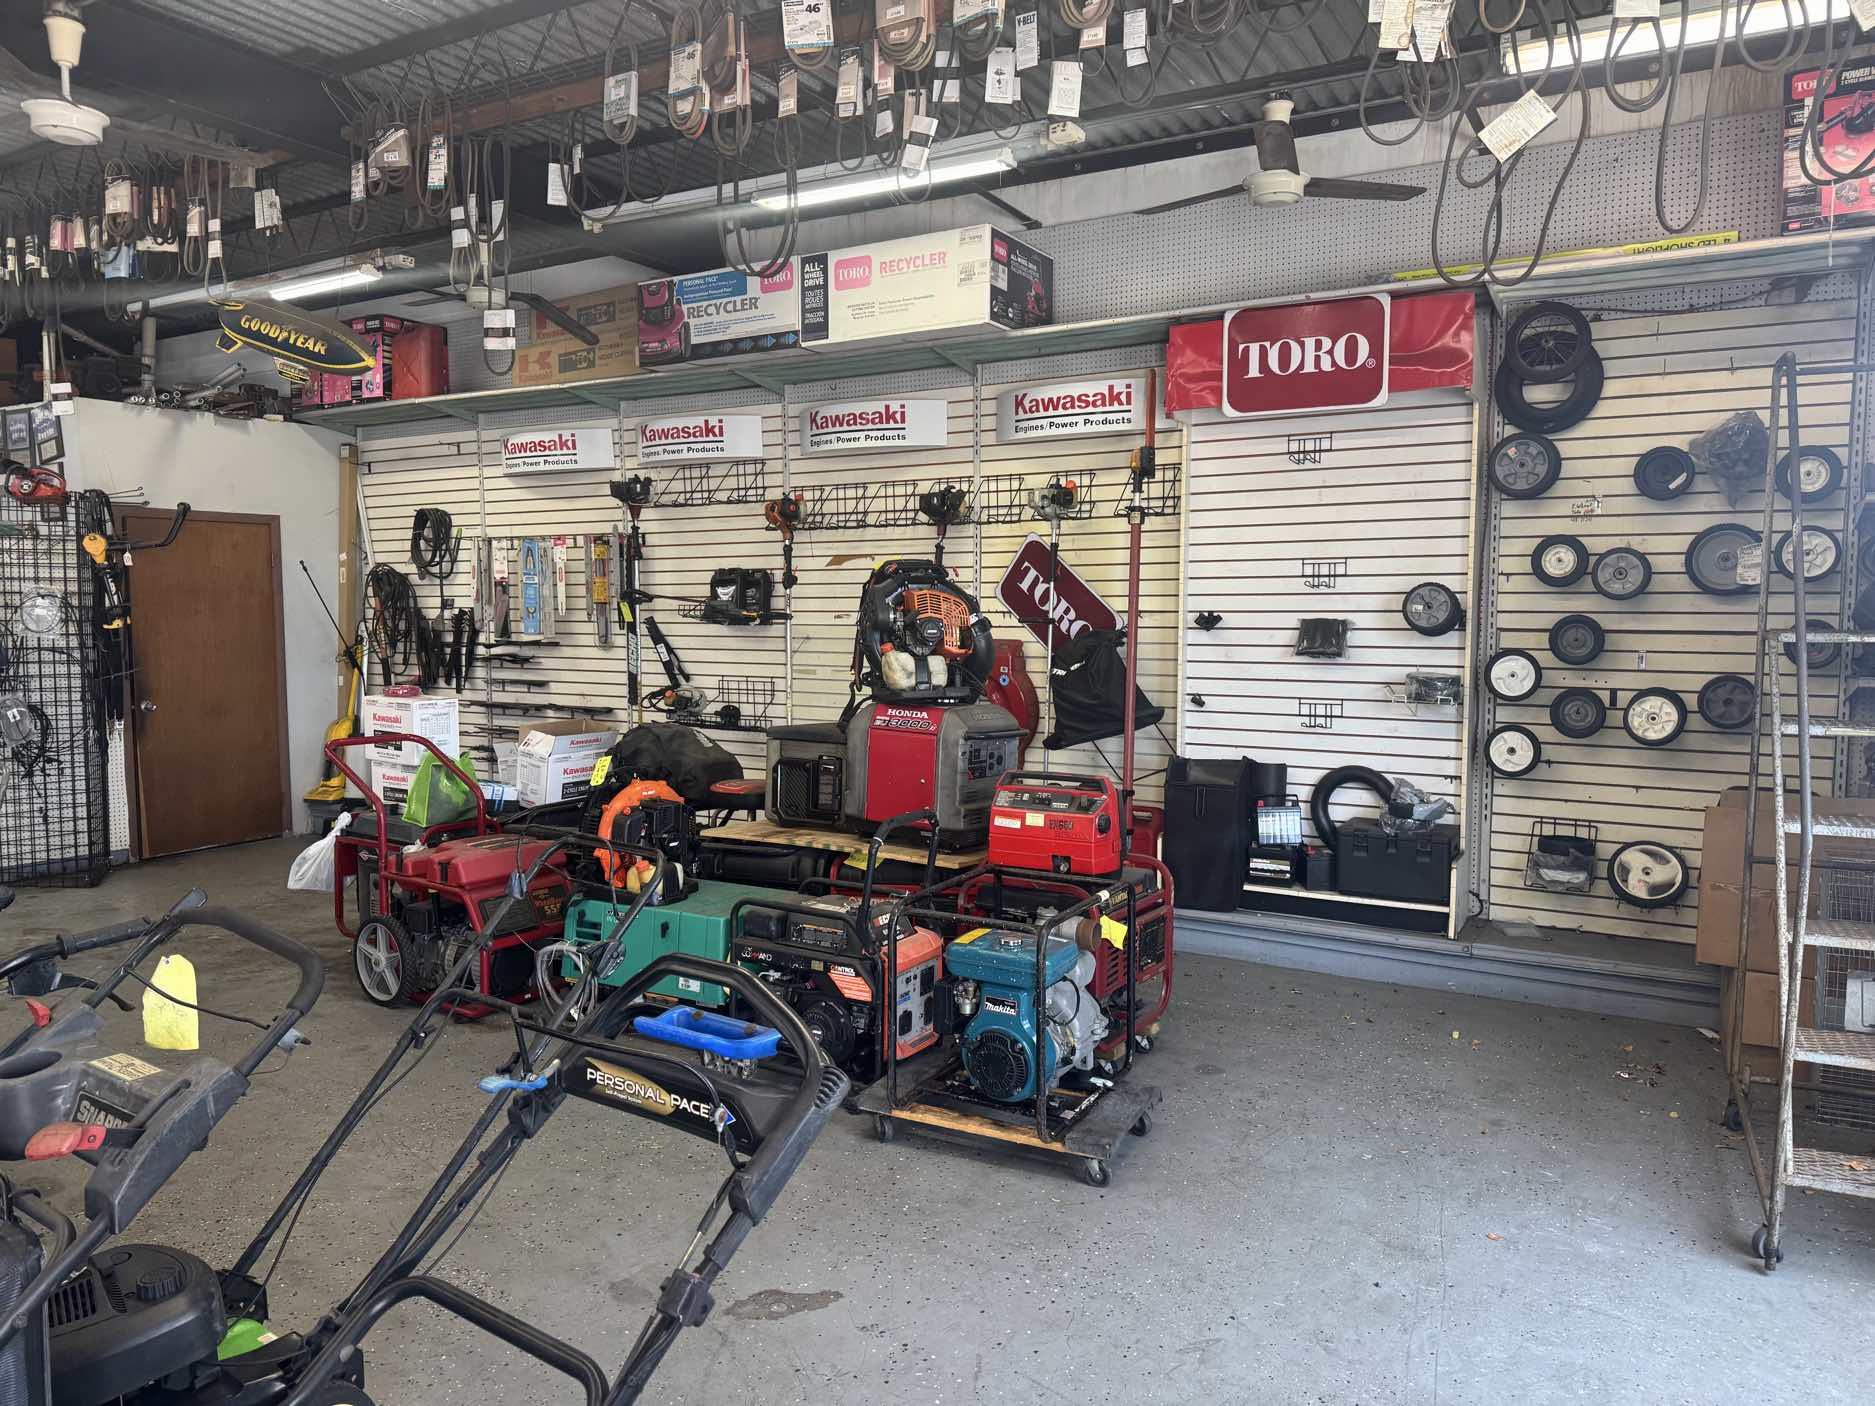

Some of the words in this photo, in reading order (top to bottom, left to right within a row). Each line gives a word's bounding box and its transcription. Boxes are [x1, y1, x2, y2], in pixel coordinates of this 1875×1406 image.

[1016, 14, 1036, 26] V-BELT
[880, 252, 947, 274] RECYCLER
[839, 266, 869, 281] TORO
[804, 278, 825, 287] DRIVE
[687, 297, 758, 319] RECYCLER
[240, 314, 328, 356] GOODYEAR
[1014, 383, 1132, 416] Kawasaki
[809, 404, 906, 431] Kawasaki
[1083, 416, 1132, 426] Products
[640, 419, 724, 443] Kawasaki
[864, 433, 906, 442] Products
[503, 432, 577, 456] Kawasaki
[686, 445, 725, 453] Products
[543, 458, 578, 466] Products
[373, 713, 402, 723] Kawasaki
[887, 708, 929, 719] HONDA
[563, 765, 596, 776] Kawasa
[587, 1068, 665, 1104] PERSONAL
[670, 1094, 711, 1118] PACE
